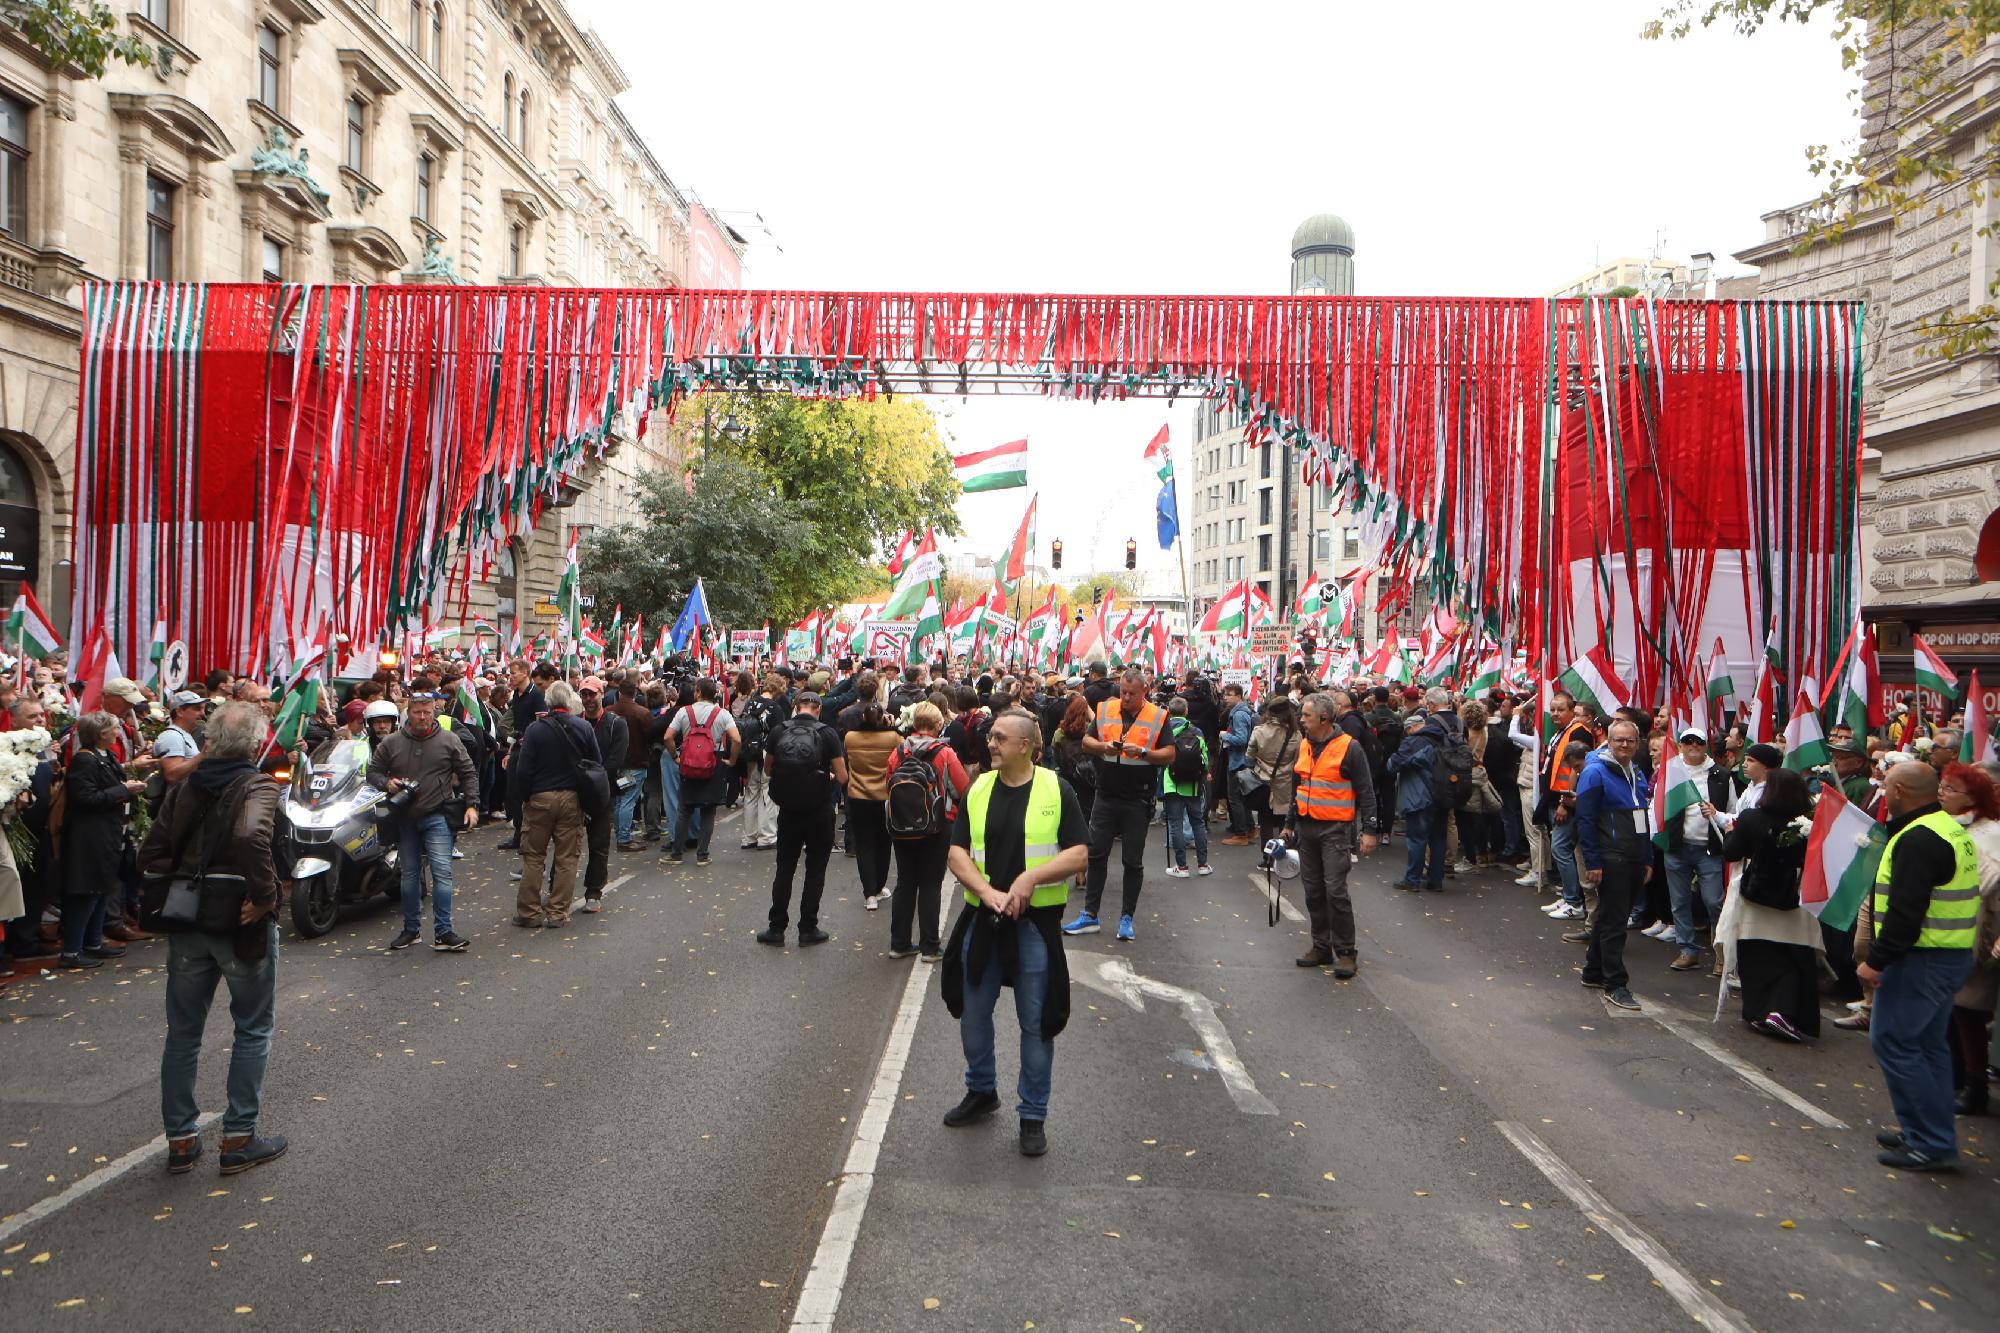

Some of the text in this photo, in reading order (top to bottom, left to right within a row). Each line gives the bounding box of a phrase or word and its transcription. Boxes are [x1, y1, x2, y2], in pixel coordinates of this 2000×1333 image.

[1938, 633, 1953, 646] ON
[1957, 632, 1979, 645] HOP
[313, 779, 326, 788] 10
